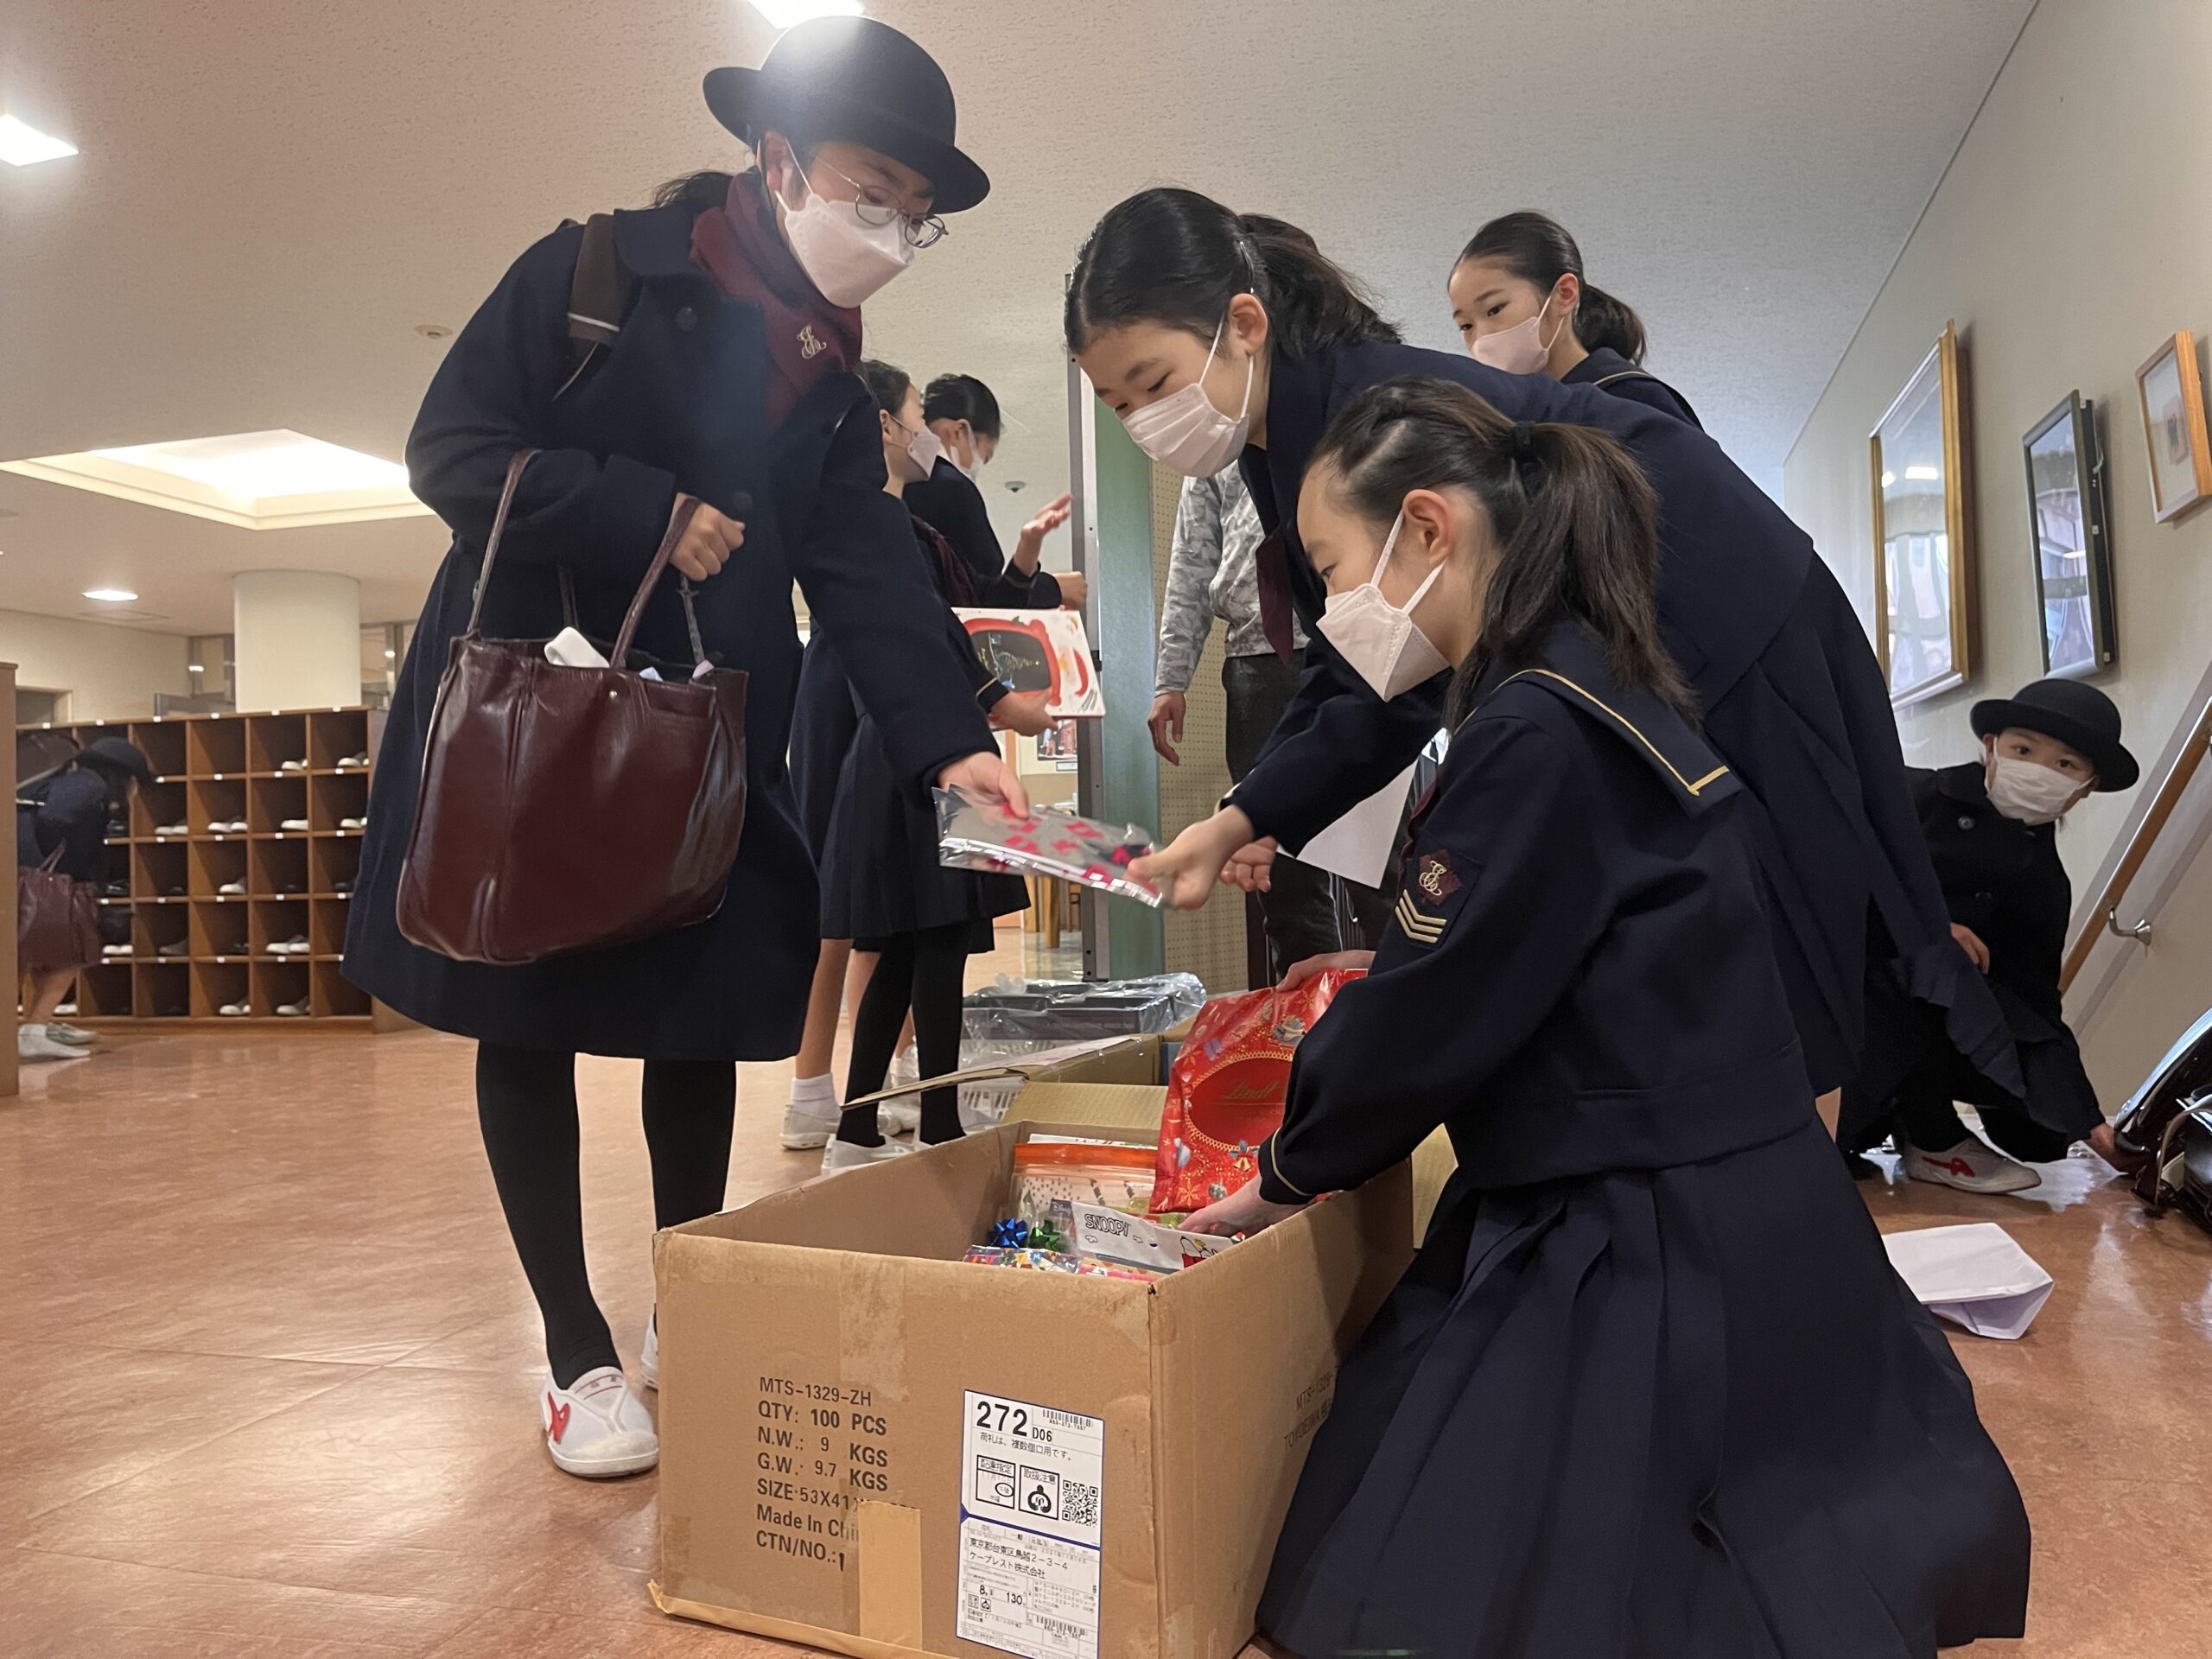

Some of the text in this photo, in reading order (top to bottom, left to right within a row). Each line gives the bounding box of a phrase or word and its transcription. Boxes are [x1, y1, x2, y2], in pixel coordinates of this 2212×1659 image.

[1084, 1212, 1132, 1237] SNOOPY
[760, 1376, 871, 1407] MTS-1329-ZH
[758, 1400, 887, 1435] QTY: 100 PCS
[976, 1401, 1028, 1437] 272
[1032, 1427, 1052, 1442] D06
[820, 1436, 830, 1452] 9
[849, 1442, 887, 1468] KGS
[815, 1460, 836, 1478] 9.7
[849, 1468, 887, 1491] KGS
[756, 1503, 859, 1542] Made In Chi
[1006, 1592, 1023, 1605] 130
